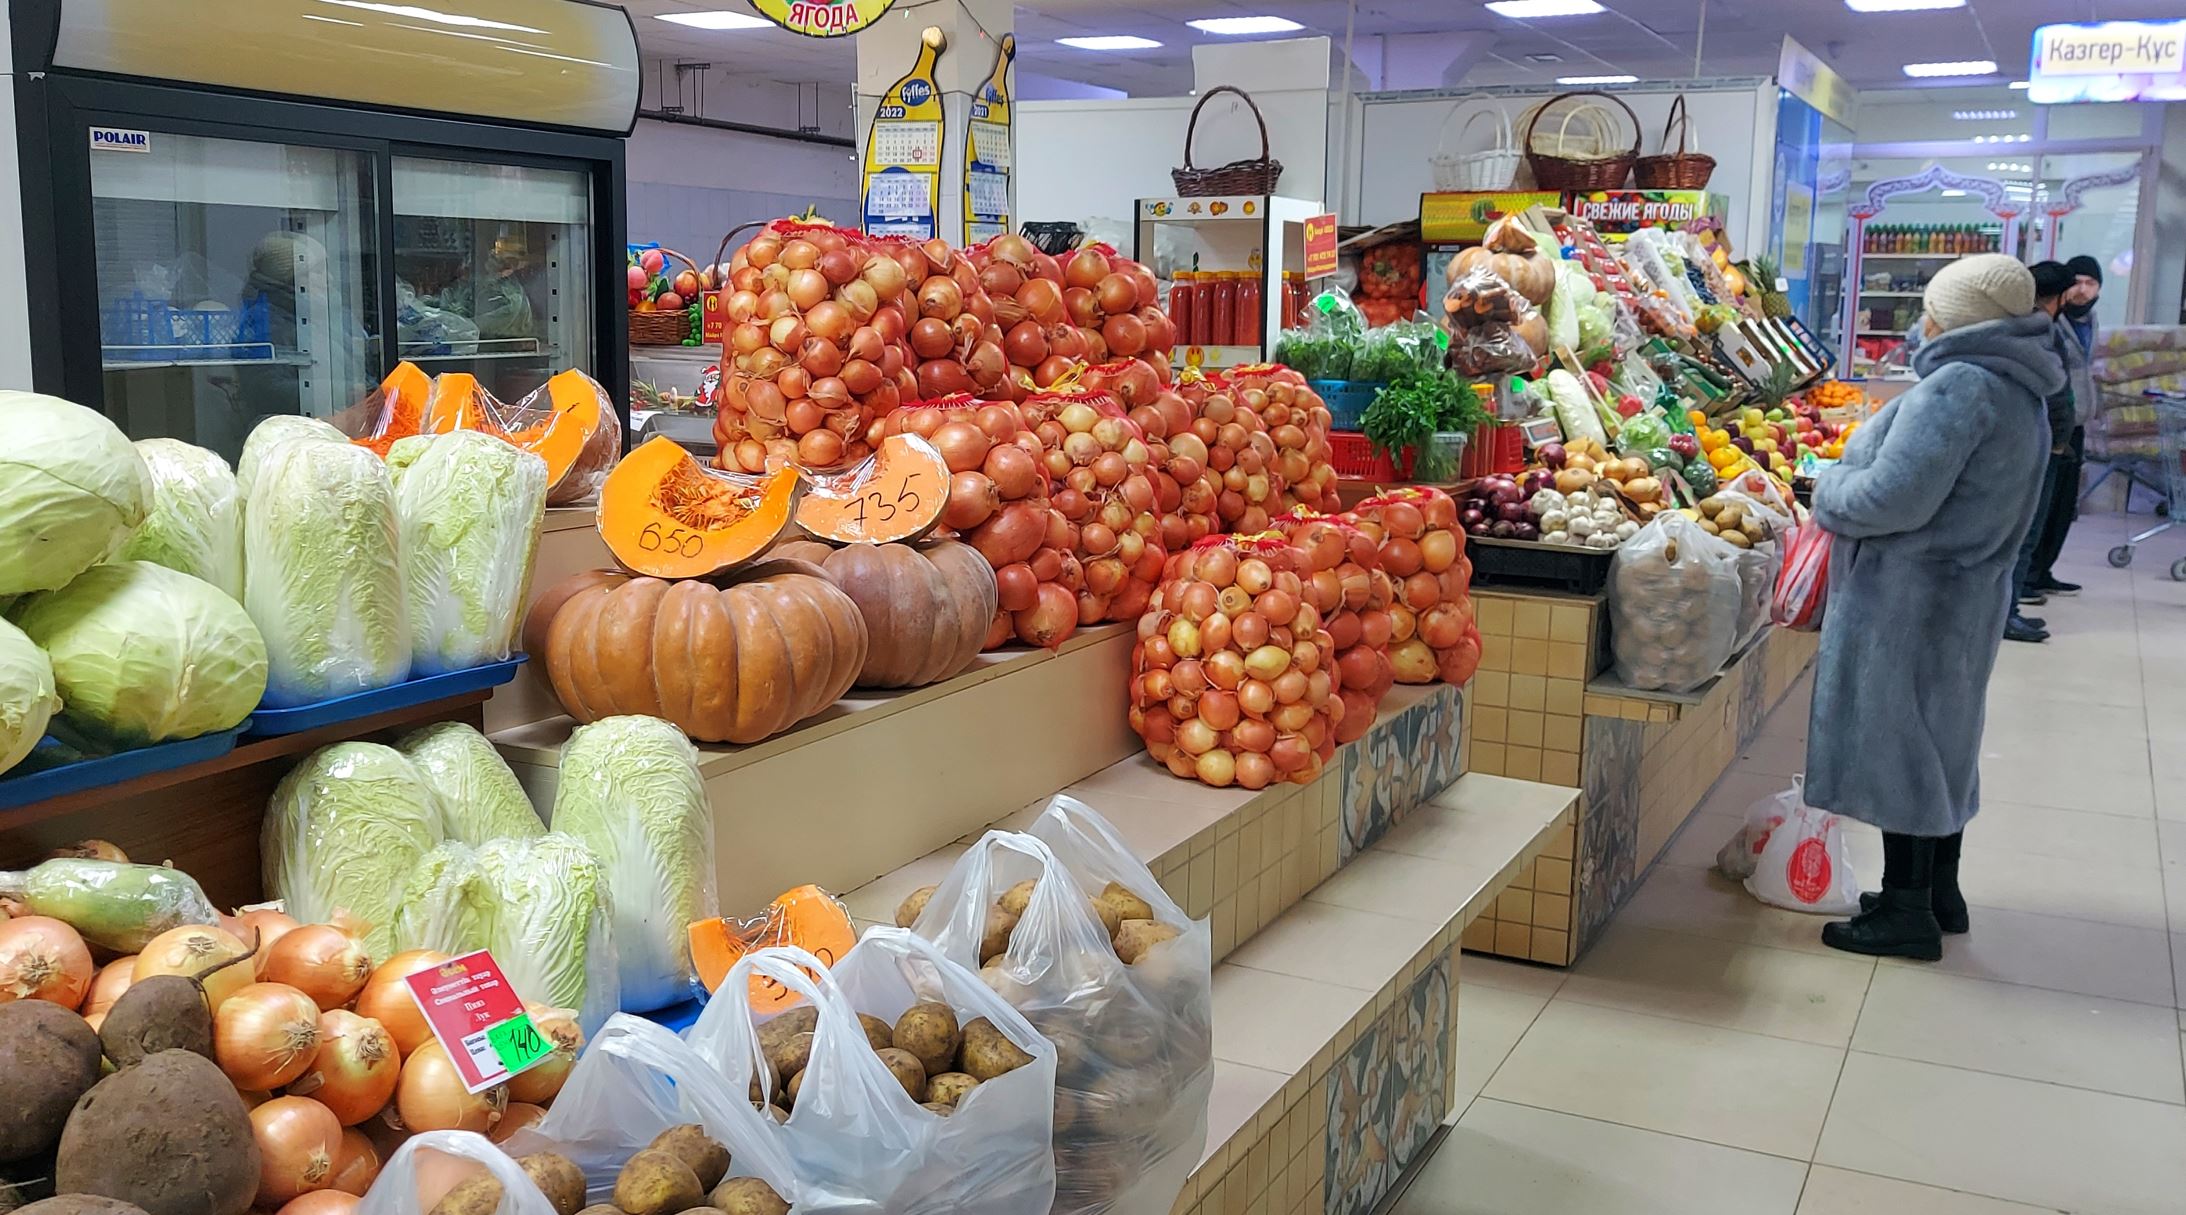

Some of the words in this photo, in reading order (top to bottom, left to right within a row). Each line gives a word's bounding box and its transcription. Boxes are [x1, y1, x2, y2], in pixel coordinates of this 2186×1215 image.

[789, 2, 860, 33] ЯГОДА
[880, 107, 904, 118] 2022
[93, 130, 147, 145] POLAIR
[1582, 201, 1641, 221] СВЕЖИЕ
[1642, 202, 1694, 221] ЯГОДЫ
[843, 473, 921, 527] 735
[638, 522, 704, 558] 650
[508, 1023, 542, 1063] 140
